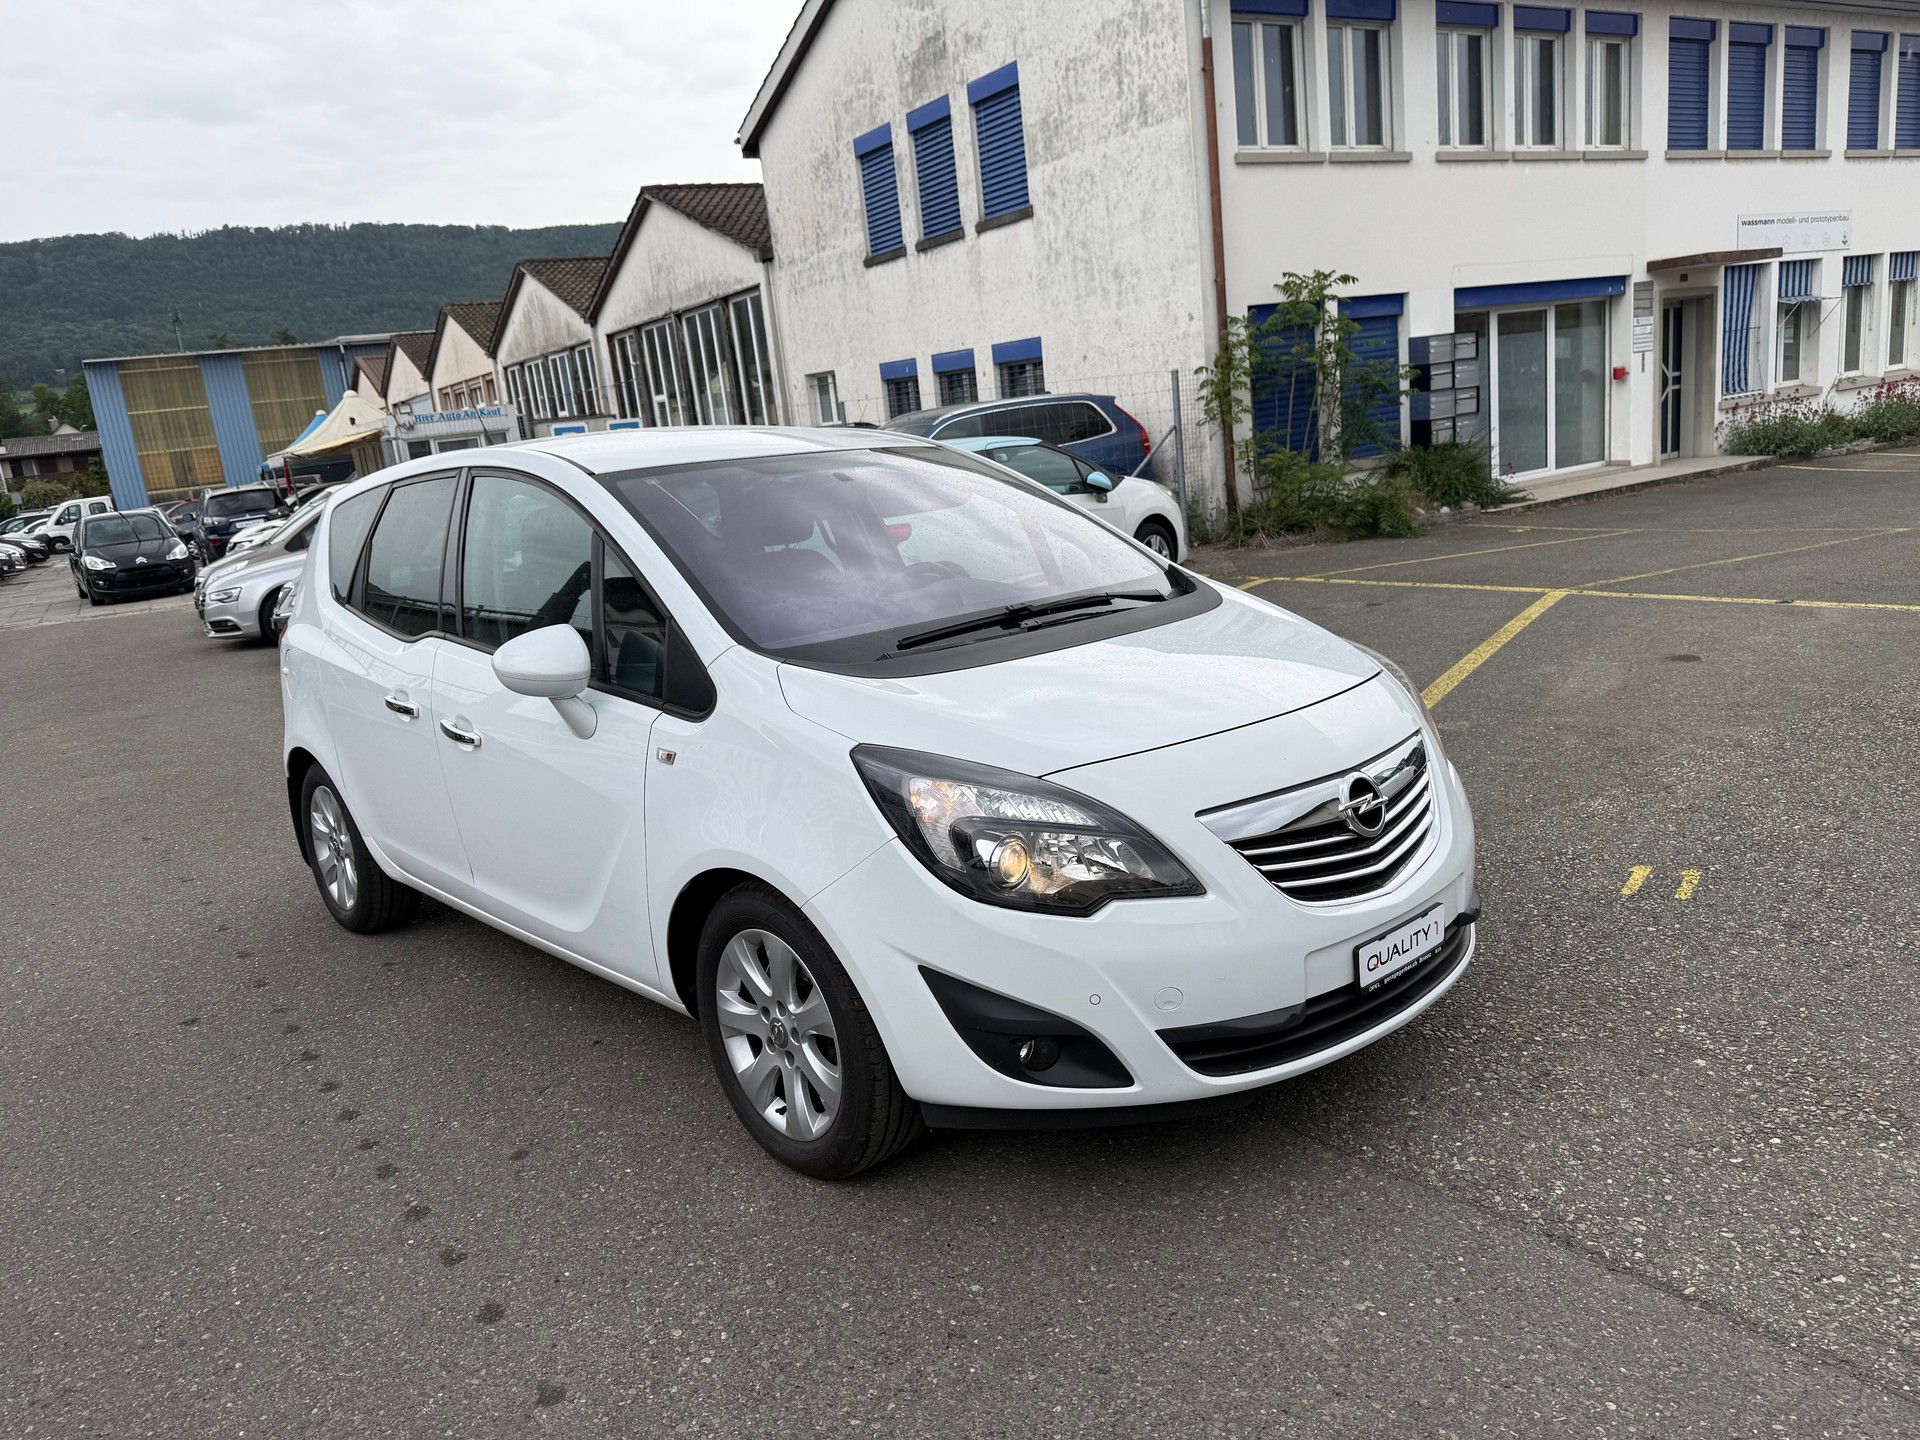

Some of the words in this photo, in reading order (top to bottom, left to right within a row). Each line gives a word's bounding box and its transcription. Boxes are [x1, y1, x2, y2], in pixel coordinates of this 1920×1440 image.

[1741, 218, 1775, 226] wassmann
[1776, 216, 1797, 225] modell-
[1810, 215, 1849, 224] prototypenbau
[414, 414, 435, 423] Hier
[438, 411, 461, 421] Auto
[463, 410, 477, 419] An
[479, 407, 501, 417] Kauf
[1367, 924, 1431, 972] QUALITY
[1434, 920, 1439, 935] 1
